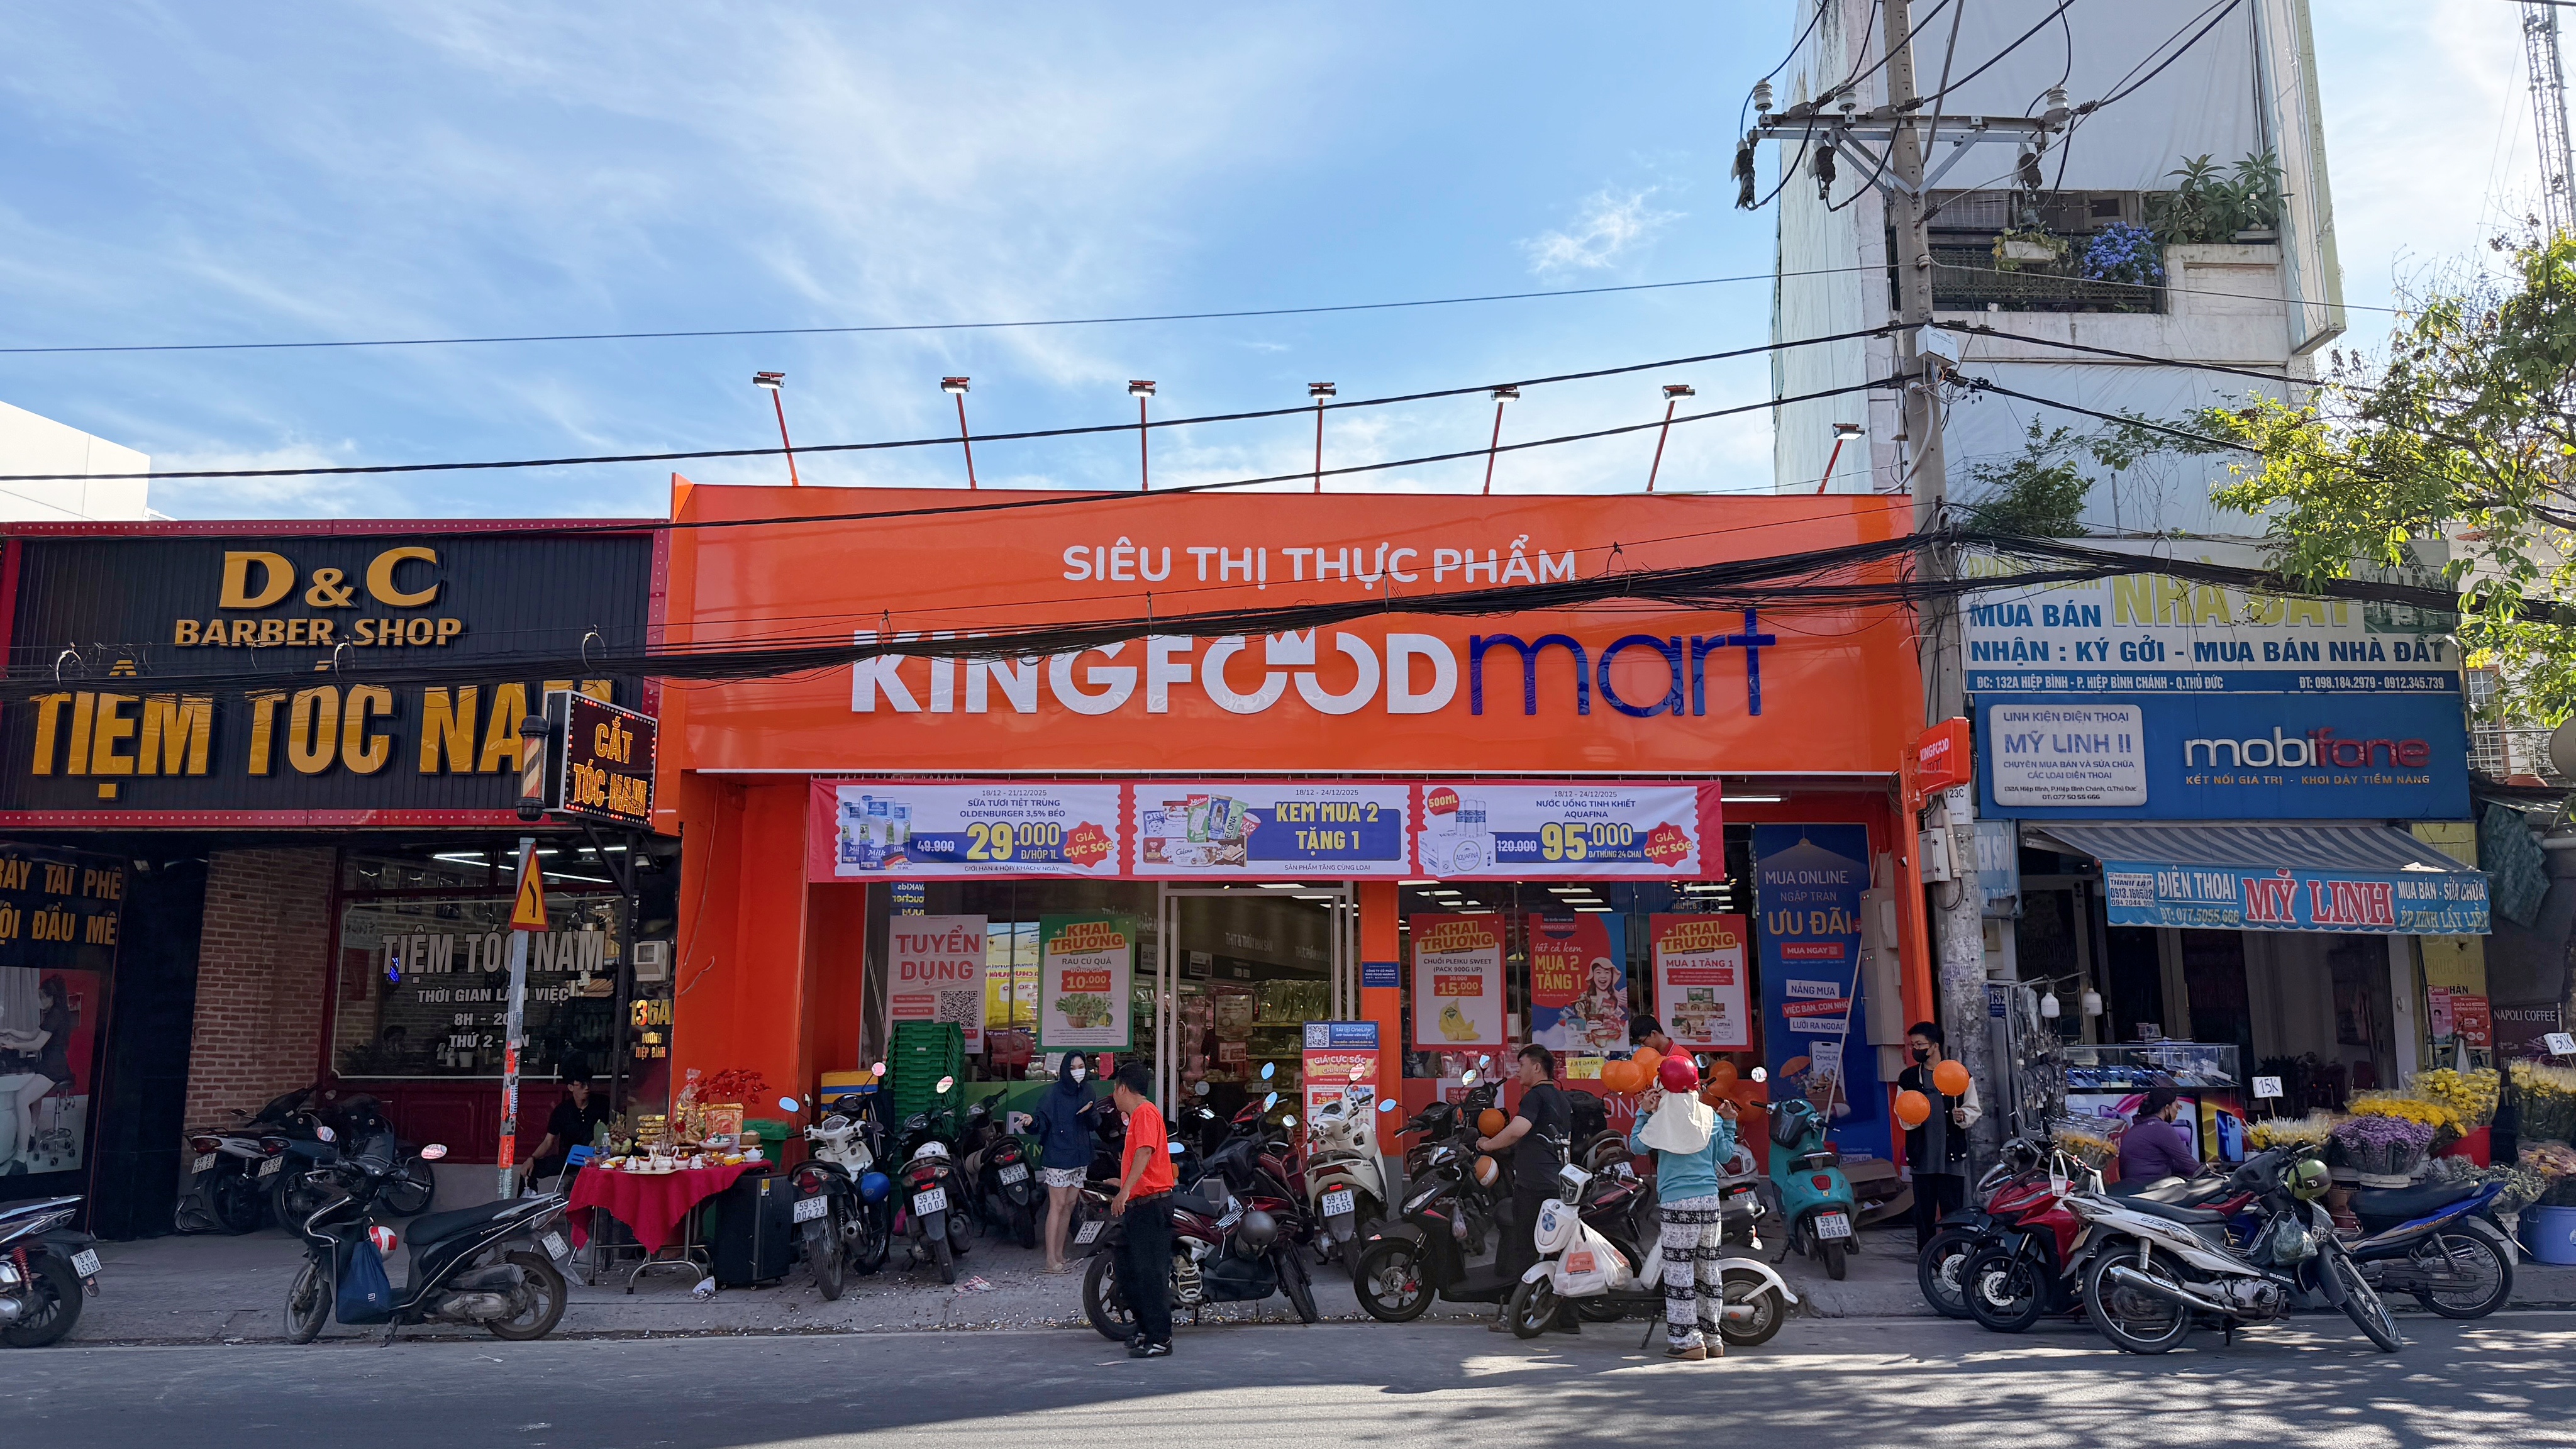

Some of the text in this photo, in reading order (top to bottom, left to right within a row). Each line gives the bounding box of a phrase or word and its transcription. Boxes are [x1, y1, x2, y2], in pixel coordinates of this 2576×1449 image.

[1063, 531, 1575, 591] SIÊU THỊ THỰC PHẨM
[175, 617, 462, 647] BARBER SHOP
[1970, 636, 2050, 666] NHẬN
[2075, 637, 2109, 662] KÝ
[2119, 634, 2165, 662] GỞI
[2194, 641, 2255, 662] MUA
[2264, 635, 2320, 662] BÁN
[2328, 637, 2386, 662] NHÀ
[1977, 675, 1993, 689] ĐC:
[1995, 675, 2019, 689] 132A
[2021, 674, 2043, 691] HIỆP
[2045, 674, 2068, 689] BÌNH
[2077, 676, 2085, 689] P.
[2086, 674, 2109, 691] HIỆP
[2111, 674, 2134, 689] BÌNH
[2136, 673, 2168, 689] CHÁNH
[2175, 672, 2202, 689] Q.THỦ
[2204, 674, 2224, 689] ĐỨC
[2299, 676, 2313, 689] ĐT:
[2315, 676, 2376, 689] 098.184.2979
[2384, 676, 2445, 689] 0912.345.739
[2003, 710, 2129, 723] LINH KIỆN ĐIỆN THOẠI
[27, 659, 614, 799] TIỆM TÓC NA
[594, 716, 633, 764] CẮT
[2004, 730, 2131, 754] MỸ LINH II
[2184, 726, 2431, 768] mobifone
[1919, 738, 1949, 762] KINGFOOD
[2027, 770, 2112, 780] CÁC LOẠI ĐIỆN THOẠI
[574, 759, 647, 816] TÓC NAM
[967, 797, 1060, 808] SỮA TƯƠI TIỆT TRÙNG
[1428, 794, 1458, 808] 500ML
[1536, 799, 1560, 808] NƯỚC
[1562, 797, 1587, 808] UỐNG
[1611, 799, 1636, 808] KHIẾT
[1026, 809, 1046, 818] 3,5%
[1048, 808, 1065, 818] BÉO
[1275, 802, 1379, 822] KEM MUA 2
[1564, 811, 1609, 819] AQUAFINA
[1075, 829, 1097, 843] GIÁ
[1295, 826, 1360, 856] TẶNG 1
[1655, 830, 1675, 843] GIÁ
[1021, 849, 1059, 862] Đ/HỘP 1L
[1455, 852, 1479, 861] AQUAFINA
[1765, 870, 1850, 885] MUA ONLINE
[1780, 889, 1837, 903] NGẬP TRÀN
[2242, 867, 2395, 927] MỸ LINH
[1767, 906, 1853, 936] ƯU ĐÃI
[2176, 908, 2240, 923] 077.5055.666
[1067, 923, 1108, 938] KHAI
[1436, 921, 1477, 936] KHAI
[1677, 921, 1719, 936] KHAI
[895, 924, 980, 954] TUYỂN
[1050, 934, 1124, 952] TRƯƠNG
[1421, 933, 1492, 950] TRƯƠNG
[1662, 933, 1735, 950] TRƯƠNG
[381, 924, 456, 984] TIỆM
[533, 930, 606, 972] NAM
[1787, 947, 1828, 955] MUA NGAY
[1080, 956, 1091, 965] CỦ
[1094, 957, 1112, 965] QUẢ
[1423, 957, 1445, 965] CHUỐI
[1535, 955, 1580, 971] MUA 2
[1666, 959, 1689, 967] MUA
[1699, 957, 1726, 969] TẶNG
[900, 961, 974, 986] DỤNG
[1535, 970, 1582, 992] TẶNG 1
[1067, 975, 1107, 989] 10.000
[1439, 982, 1479, 996] 15.000
[1790, 981, 1836, 996] NẮNG MƯA
[629, 999, 671, 1026] 136A
[2494, 1009, 2557, 1022] NAPOLI COFFEE
[635, 1045, 666, 1060] HIỆP BÌNH
[1314, 1054, 1367, 1065] GIÁ CỰC SỐC
[2258, 1079, 2279, 1094] 15K
[799, 1198, 821, 1211] 59-S1
[918, 1191, 940, 1204] 59-X3
[1326, 1192, 1347, 1204] 59-X3
[796, 1206, 824, 1221] 002.23
[917, 1199, 945, 1214] 610.03
[1326, 1201, 1352, 1215] 726.55
[1820, 1216, 1844, 1227] 59-TA
[2141, 1217, 2179, 1231] REVO
[1821, 1225, 1848, 1237] 096.66
[2268, 1272, 2296, 1284] SUZUKI
